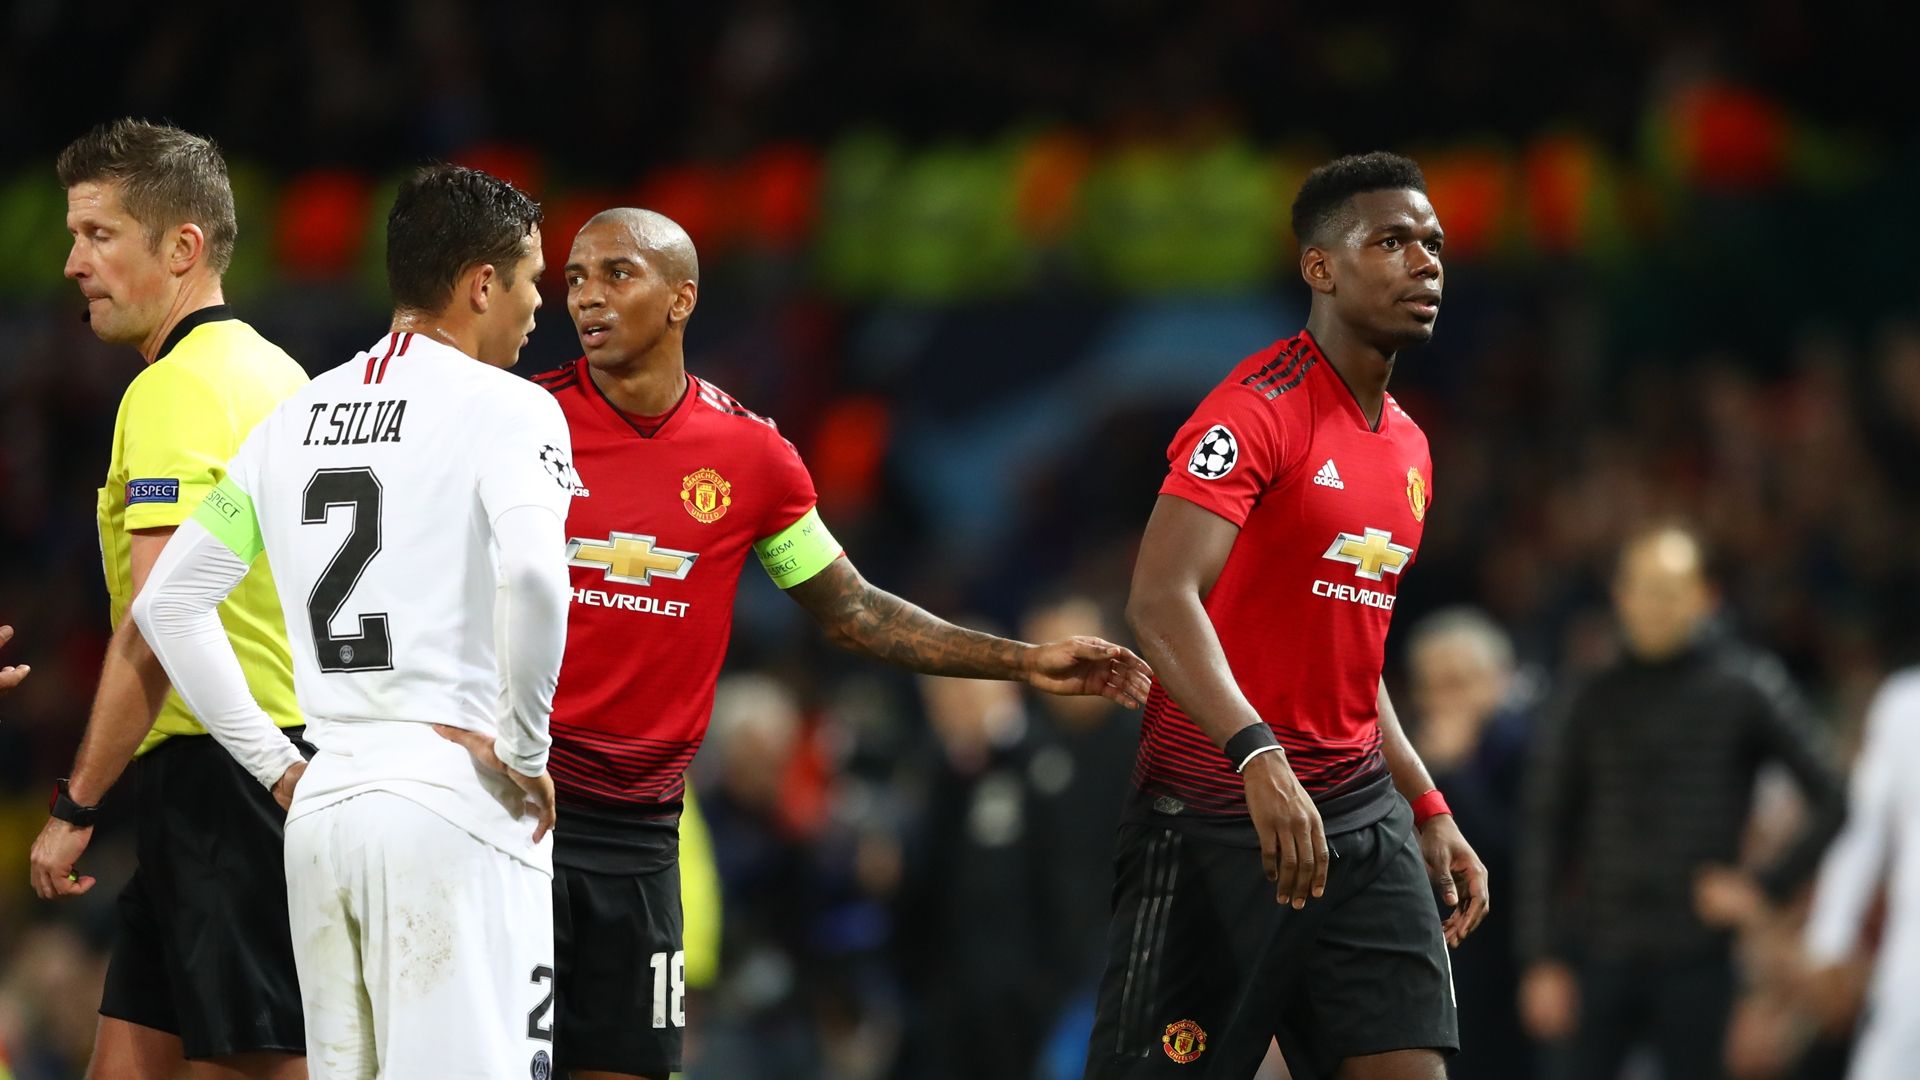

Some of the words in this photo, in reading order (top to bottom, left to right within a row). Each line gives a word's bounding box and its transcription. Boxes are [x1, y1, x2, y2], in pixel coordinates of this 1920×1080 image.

[303, 400, 407, 446] T.SILVA
[130, 485, 178, 497] RESPECT
[686, 472, 727, 492] MANCHESTER
[1314, 475, 1344, 490] adidas
[205, 489, 240, 519] SPECT
[691, 509, 719, 520] UNITED
[301, 466, 394, 674] 2
[568, 586, 690, 618] HEVROLET
[1312, 579, 1396, 610] CHEVROLET
[526, 963, 553, 1043] 2
[650, 950, 686, 1029] 18
